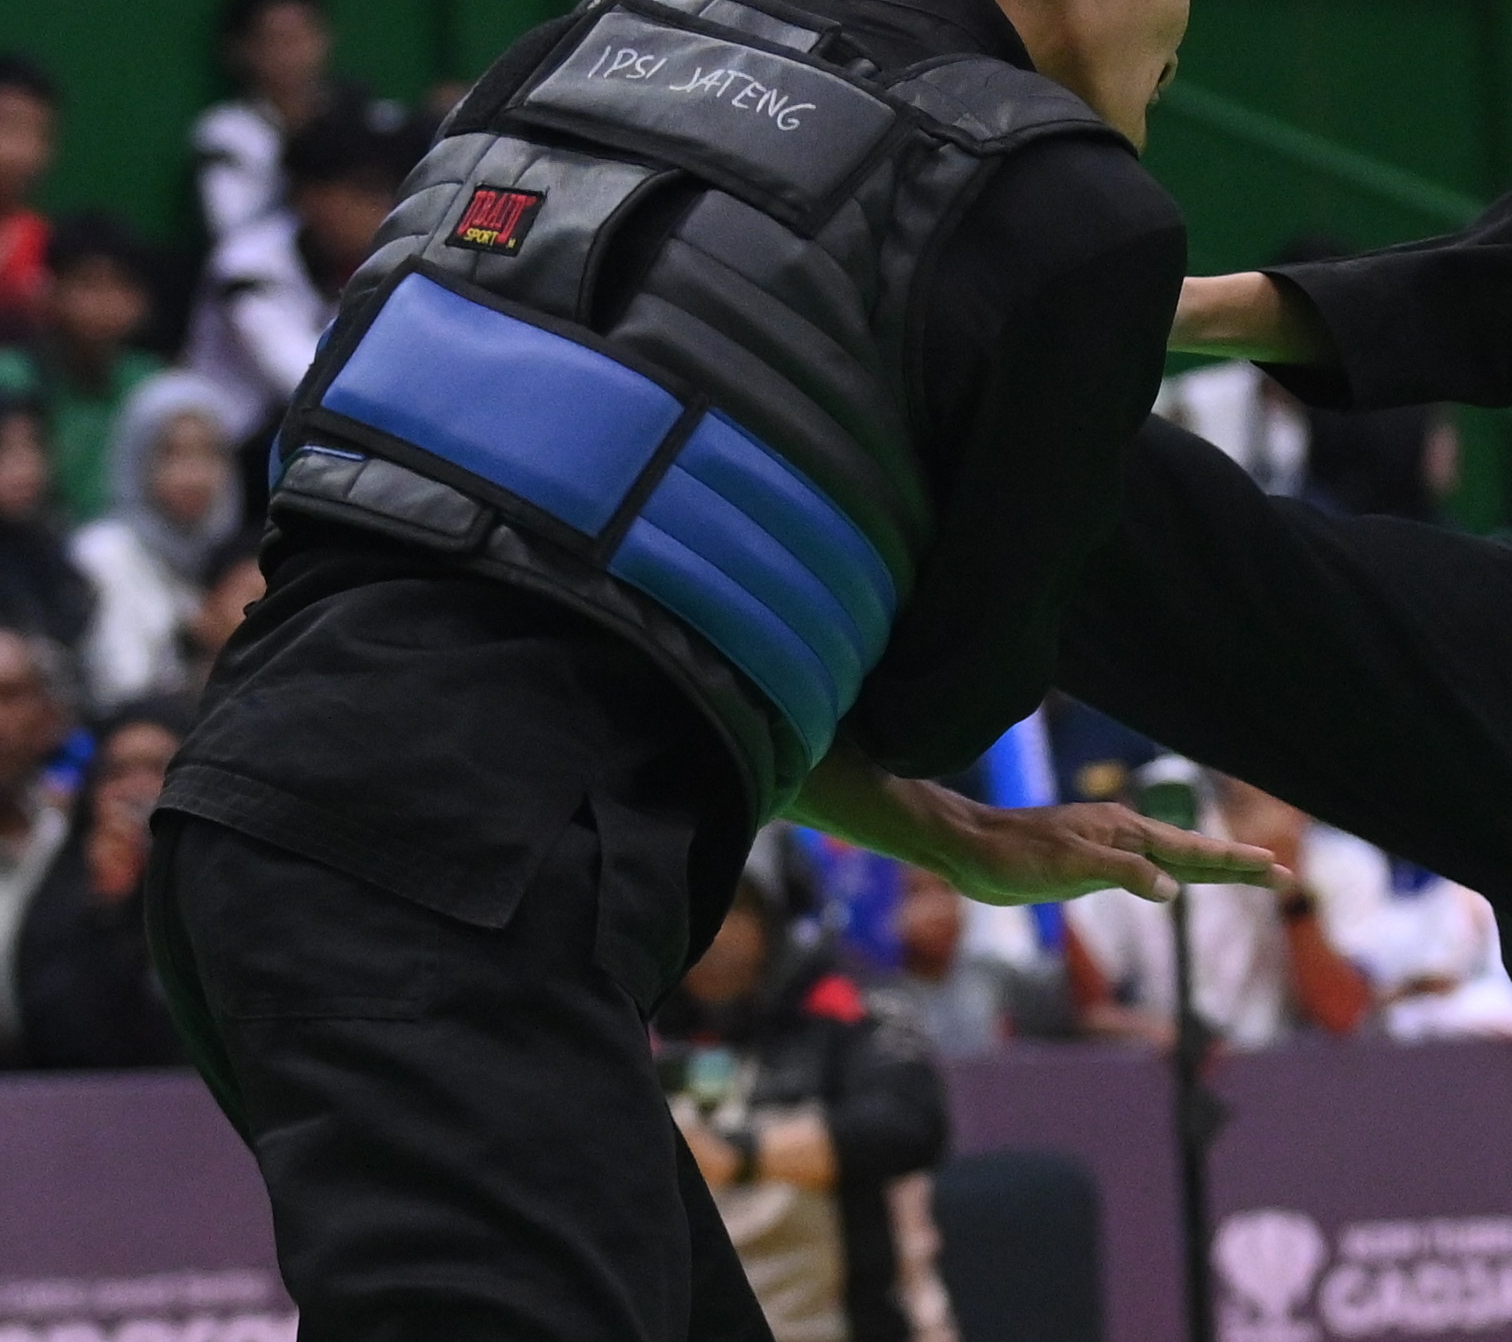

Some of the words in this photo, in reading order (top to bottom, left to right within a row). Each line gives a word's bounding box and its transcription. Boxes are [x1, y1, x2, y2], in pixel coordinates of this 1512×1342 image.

[587, 44, 669, 80] IPSI
[668, 66, 818, 132] JATENG
[463, 227, 500, 247] SPORT
